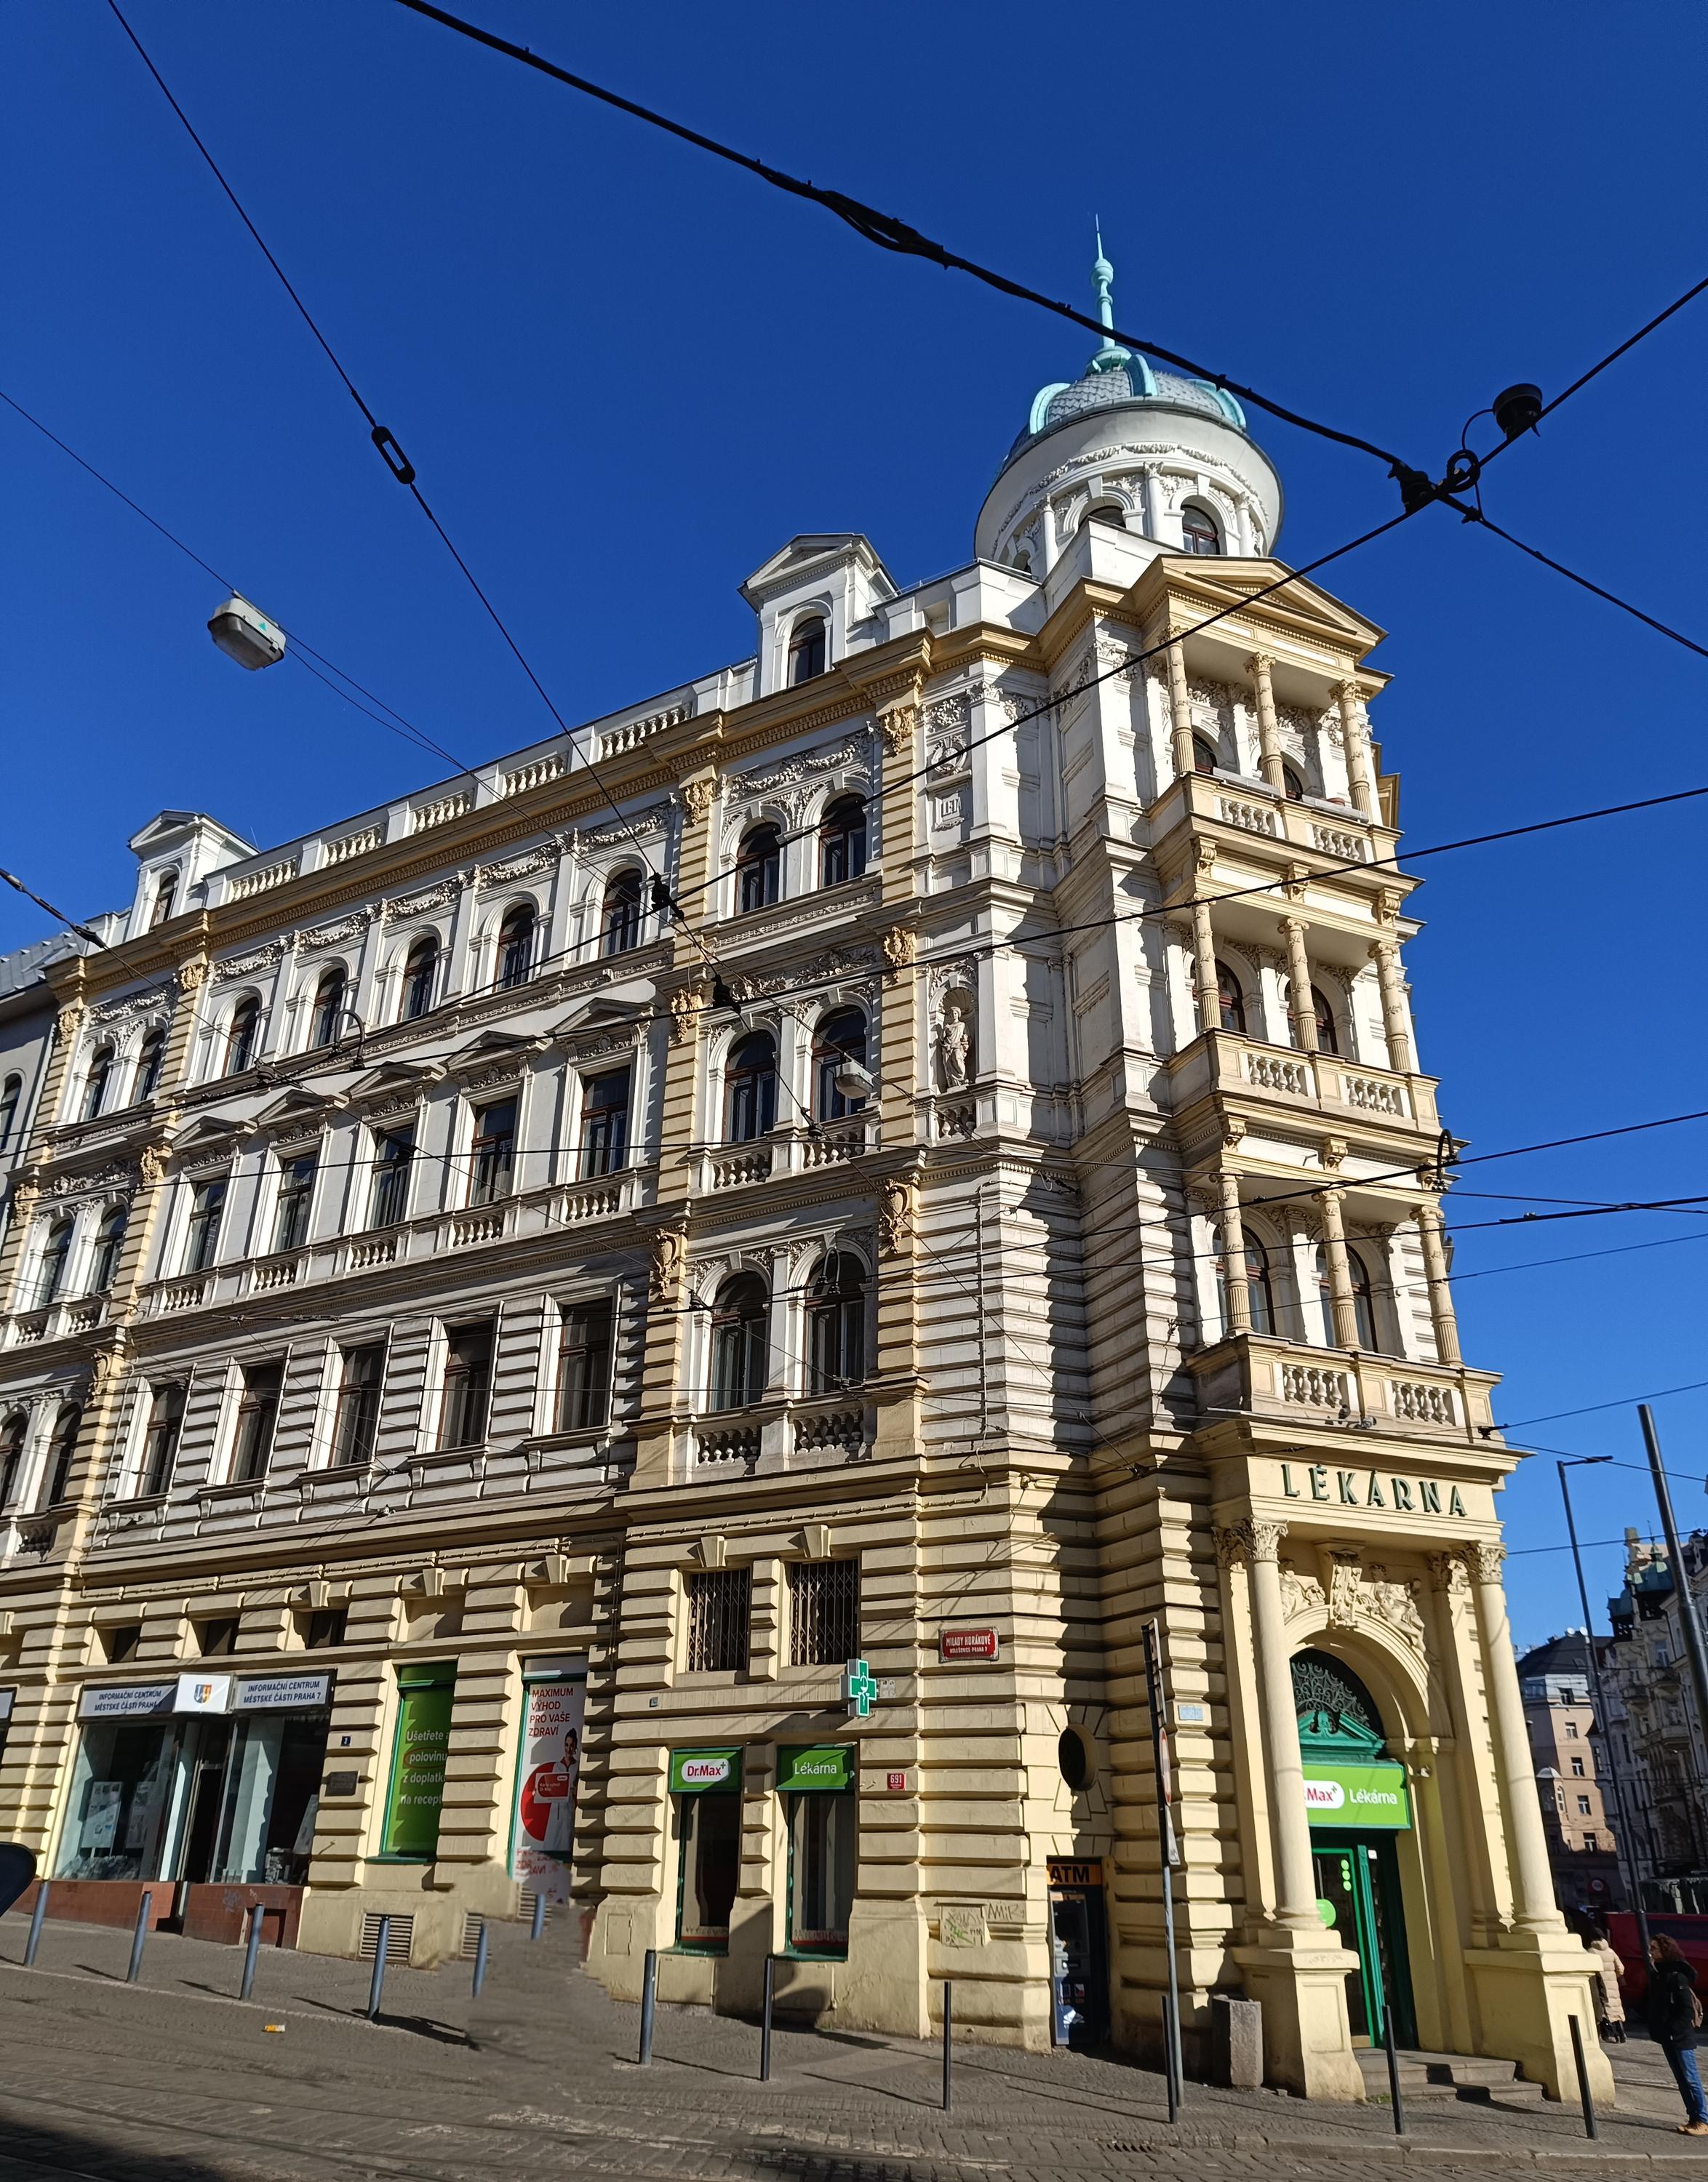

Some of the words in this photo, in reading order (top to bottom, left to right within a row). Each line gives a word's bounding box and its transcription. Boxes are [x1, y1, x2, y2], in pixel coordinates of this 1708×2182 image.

[1280, 1463, 1468, 1517] LÉKÁRNA
[946, 1637, 964, 1647] MILADY
[965, 1633, 991, 1645] HORÁKOVÉ
[248, 1681, 287, 1693] INFORMAČNÍ
[289, 1680, 320, 1690] CENTRUM
[532, 1687, 573, 1698] MAXIMUM
[99, 1690, 133, 1700] INFORMAČNÍ
[134, 1690, 161, 1699] CENTRUM
[243, 1693, 272, 1703] MĚSTSKÉ
[274, 1692, 292, 1701] ČÁSTI
[293, 1692, 315, 1701] PRAHA
[121, 1701, 137, 1709] ČÁSTI
[531, 1700, 561, 1711] VÝHOD
[530, 1714, 547, 1724] PRO
[549, 1711, 570, 1722] VAŠE
[407, 1730, 444, 1742] Ušetřete
[528, 1725, 559, 1737] ZDRAVÍ
[410, 1750, 447, 1765] polovinu
[794, 1761, 837, 1775] Lékárna
[403, 1775, 408, 1783] z
[890, 1774, 902, 1783] 691
[401, 1794, 411, 1805] na
[1349, 1787, 1398, 1805] Lékárna
[1050, 1865, 1090, 1883] ATM
